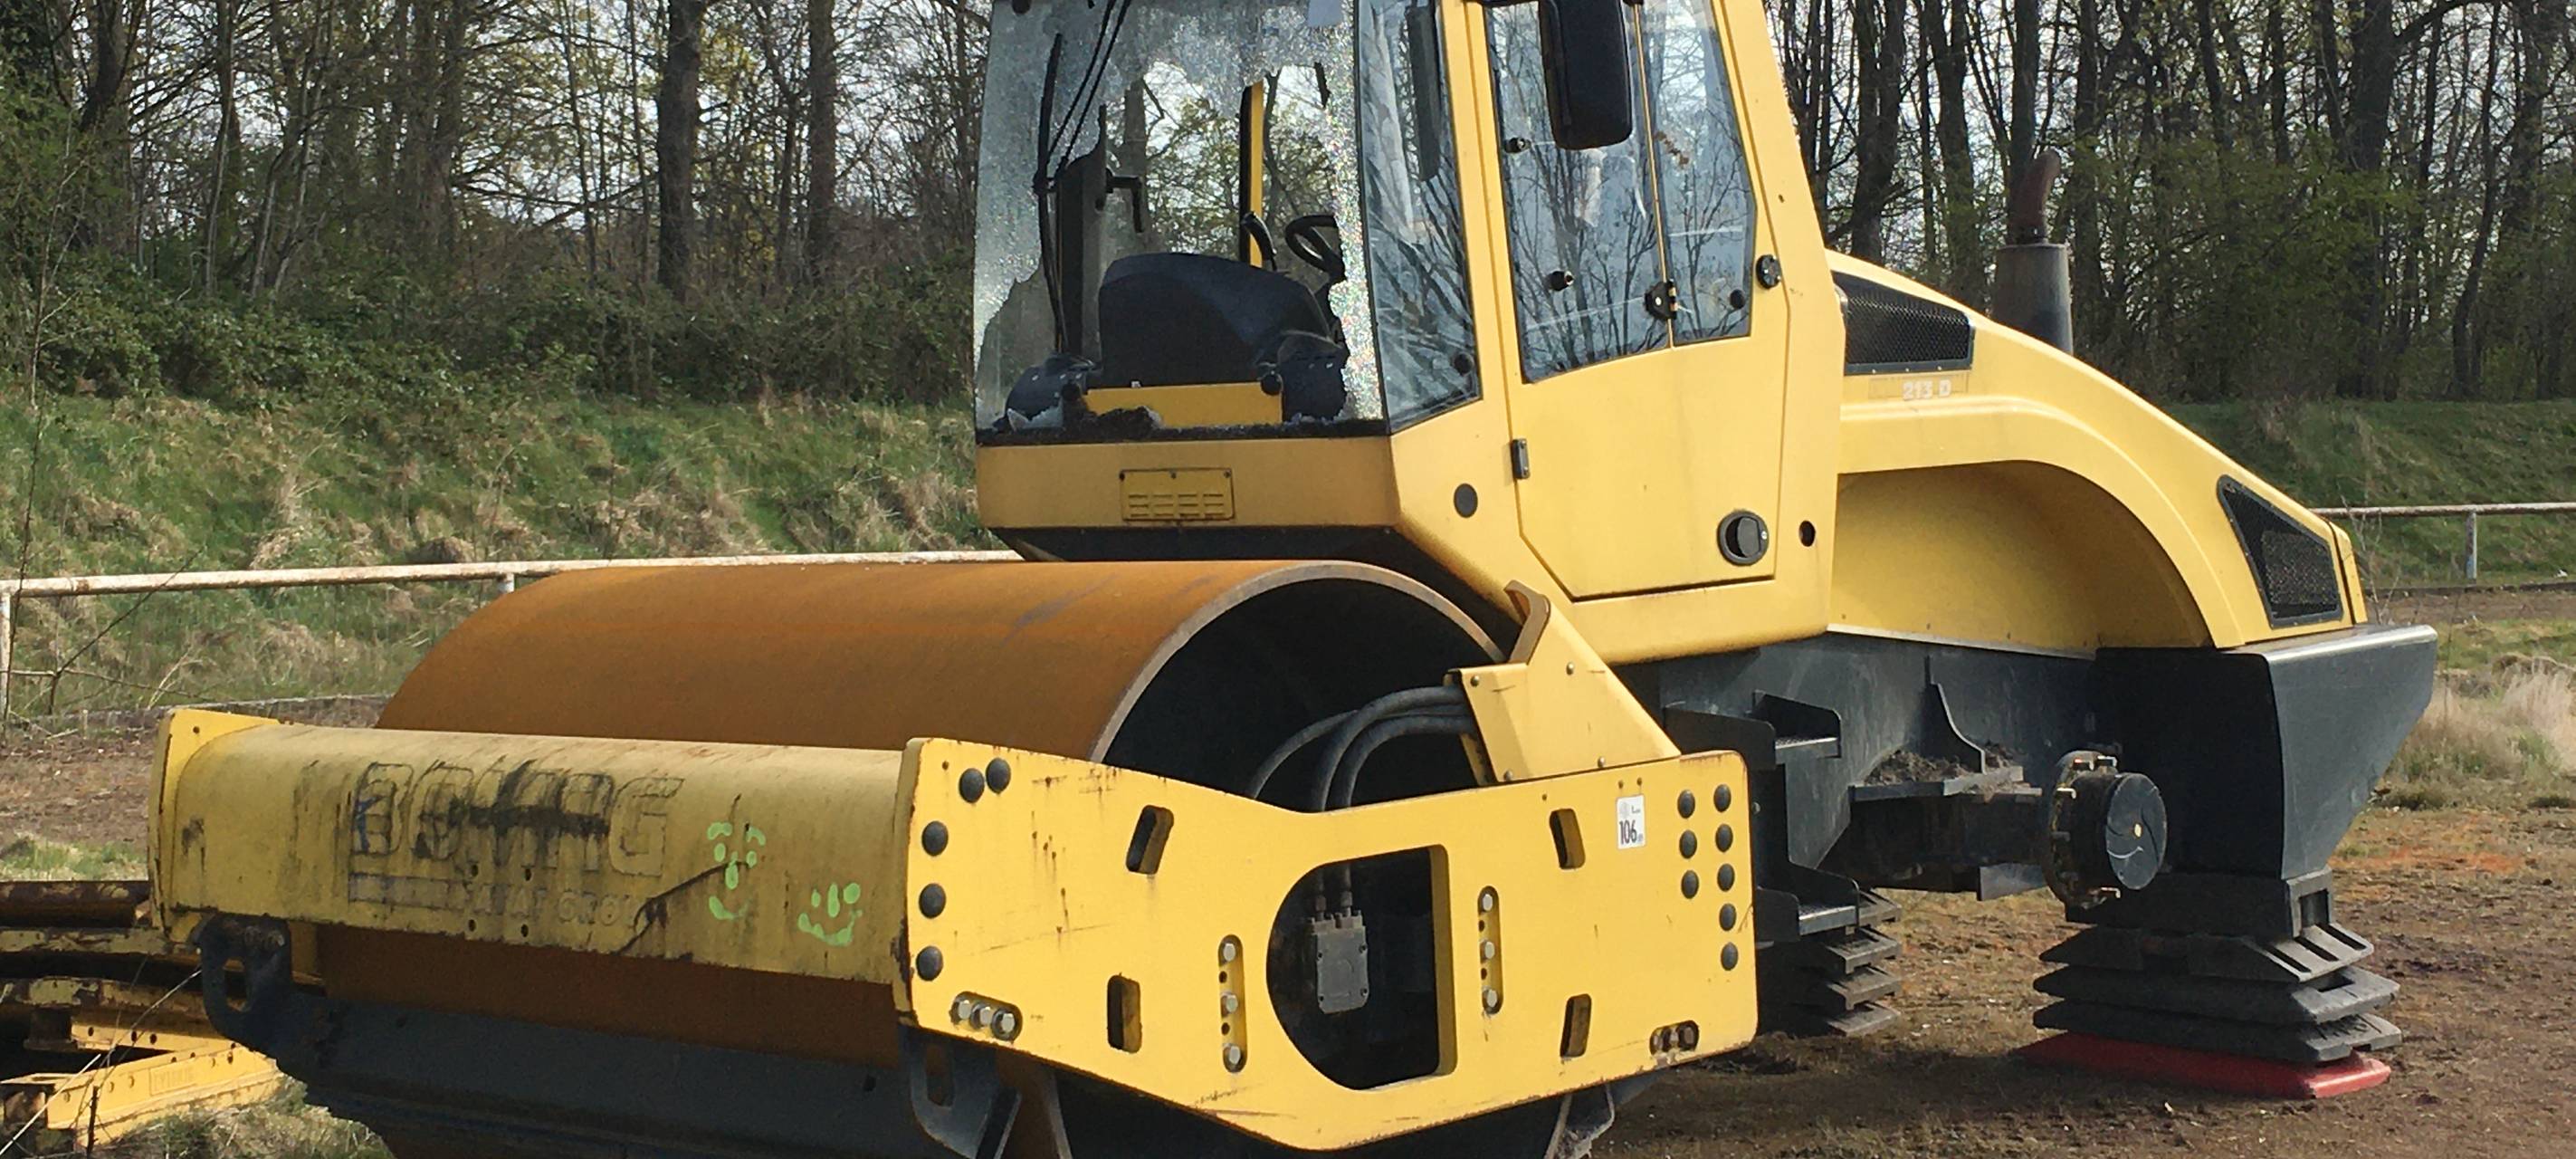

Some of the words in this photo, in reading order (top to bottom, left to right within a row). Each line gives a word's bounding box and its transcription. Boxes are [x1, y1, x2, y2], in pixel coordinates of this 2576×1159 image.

[1903, 379, 1933, 400] 213
[1938, 378, 1951, 398] D
[1619, 819, 1637, 845] 106
